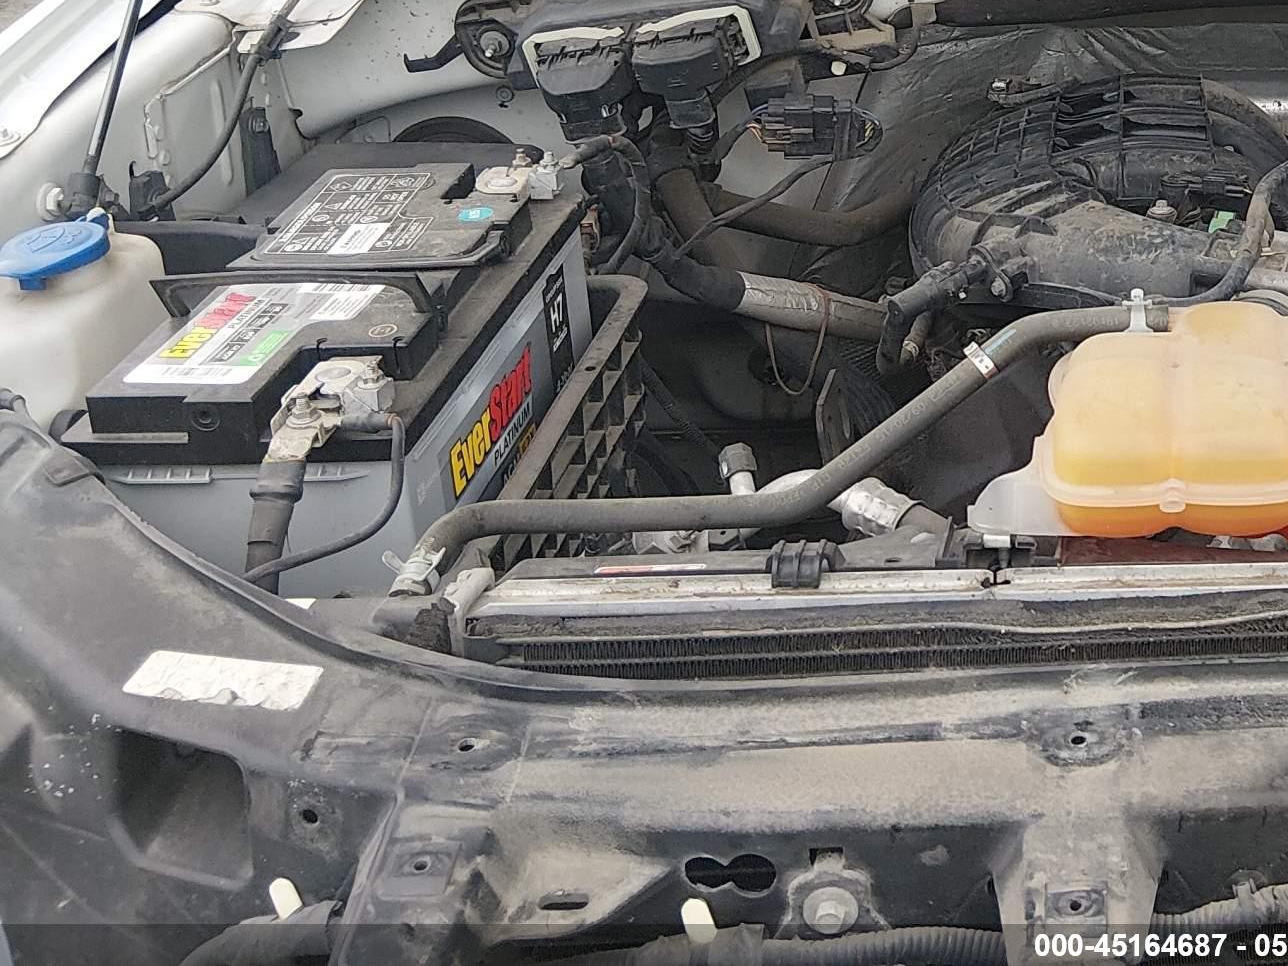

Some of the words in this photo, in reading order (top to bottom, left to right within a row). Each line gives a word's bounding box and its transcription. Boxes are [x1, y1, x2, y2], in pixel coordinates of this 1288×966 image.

[550, 292, 563, 333] H7
[450, 345, 533, 499] EverStart
[493, 401, 532, 467] PLATINUM
